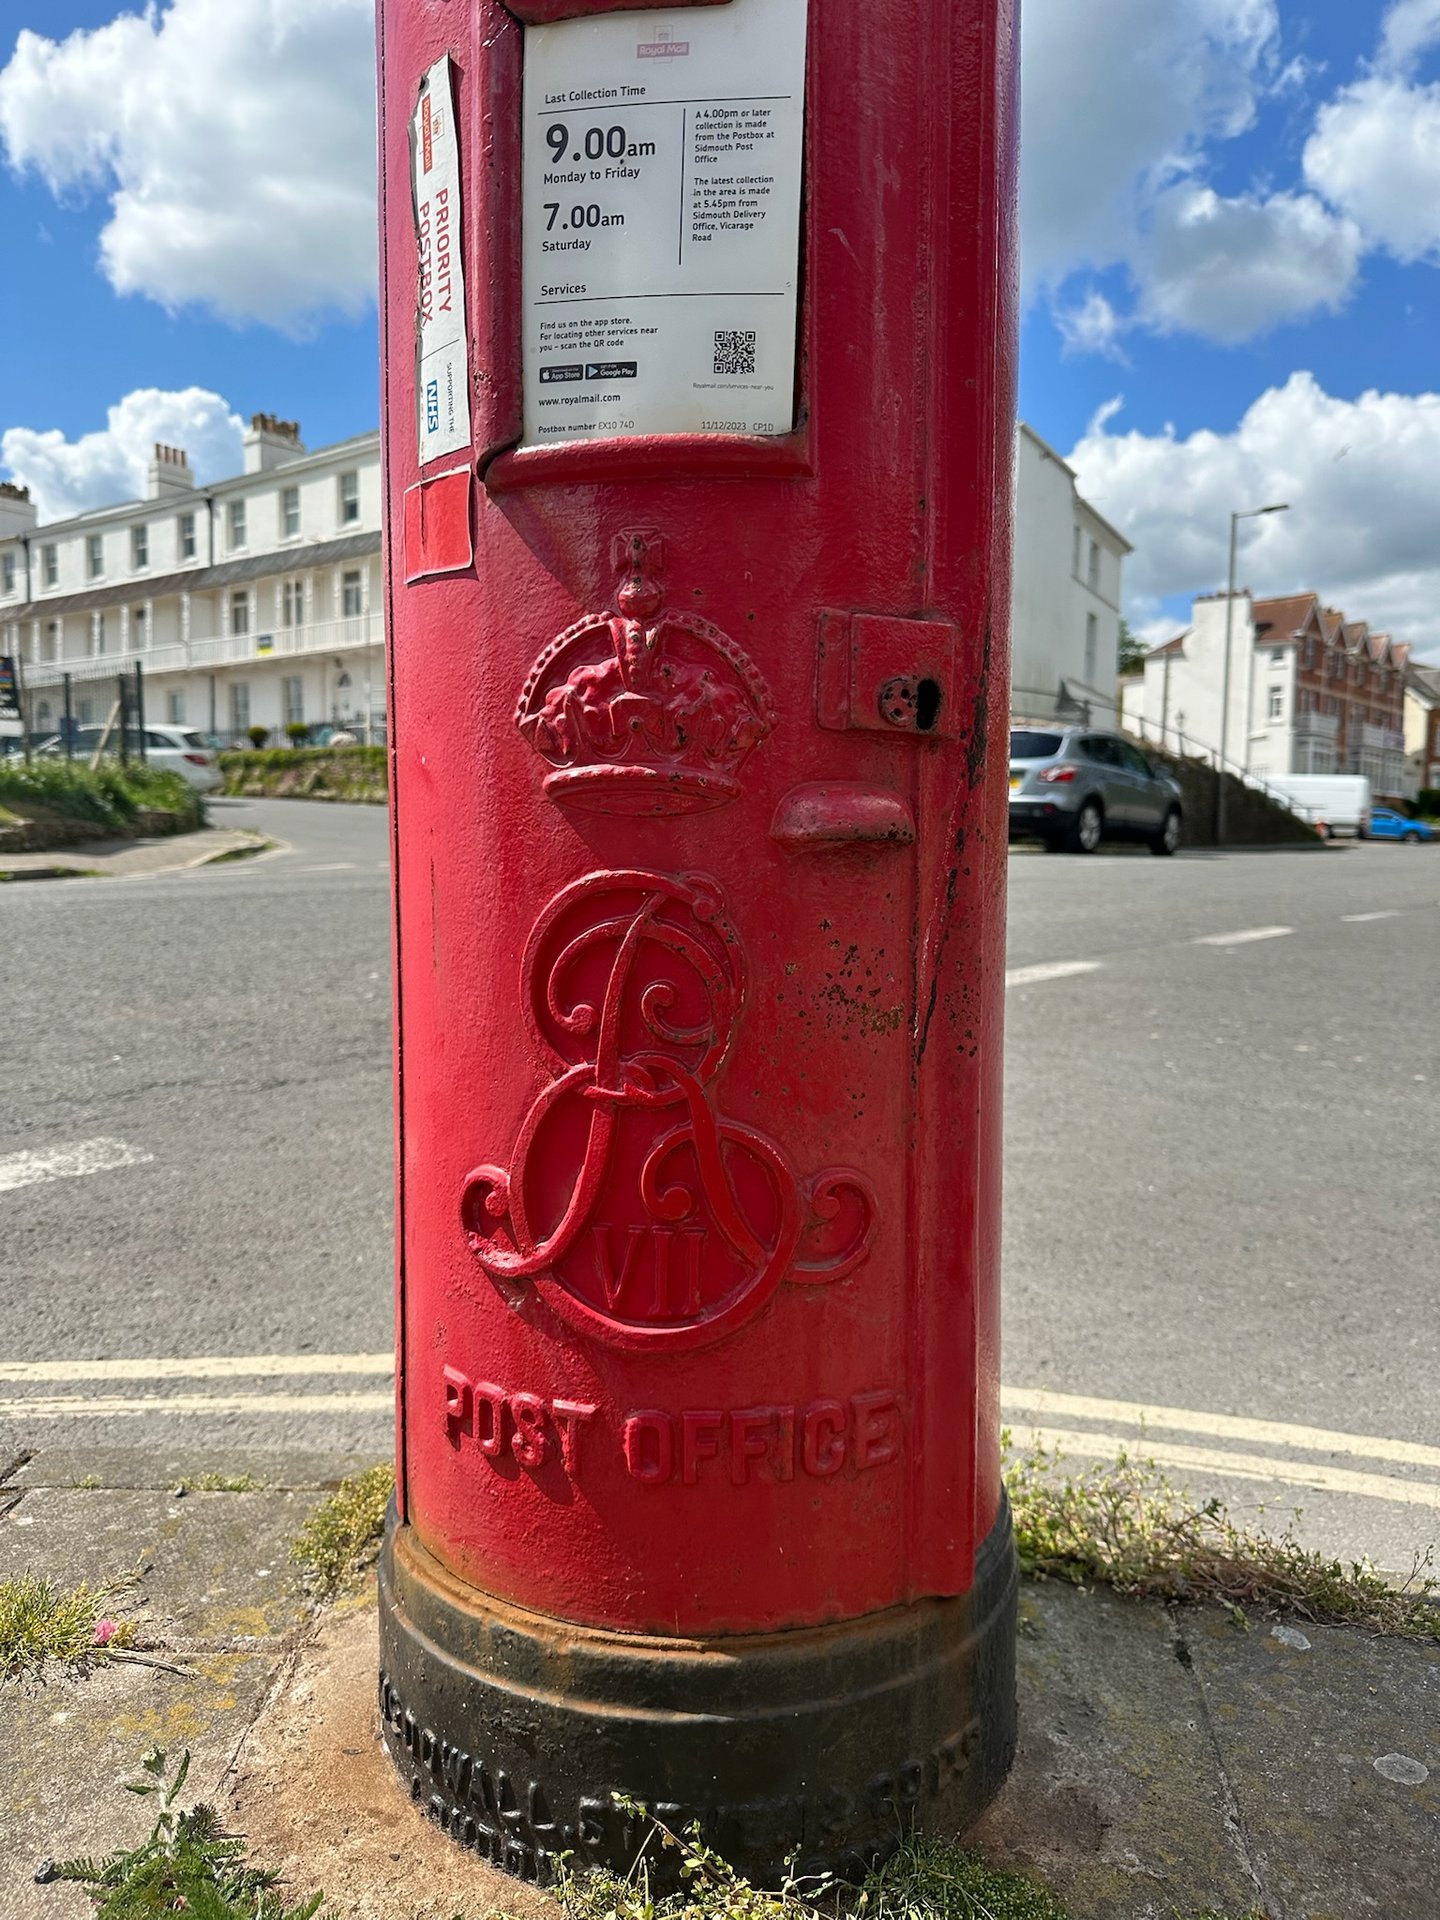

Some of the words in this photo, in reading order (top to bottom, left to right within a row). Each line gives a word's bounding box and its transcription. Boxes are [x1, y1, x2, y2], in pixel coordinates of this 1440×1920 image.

[639, 45, 665, 57] Royal
[545, 93, 566, 104] Last
[569, 88, 617, 101] Collection
[620, 86, 646, 97] Time
[423, 100, 431, 138] Royal
[695, 111, 701, 119] A
[703, 109, 738, 119] 4.00pm
[741, 110, 750, 118] or
[752, 109, 771, 117] later
[695, 121, 733, 130] collection
[735, 120, 742, 129] is
[745, 120, 767, 128] made
[695, 133, 714, 141] from
[717, 132, 730, 140] the
[732, 131, 764, 140] Postbox
[766, 131, 775, 139] at
[546, 123, 655, 164] 9.00am
[695, 143, 733, 153] Sidmouth
[735, 142, 753, 151] Post
[424, 139, 432, 170] Mail
[694, 155, 718, 163] Office
[543, 171, 586, 185] Monday
[590, 170, 601, 180] to
[605, 166, 640, 179] Friday
[694, 177, 709, 185] The
[711, 177, 734, 185] latest
[736, 175, 774, 184] collection
[693, 188, 701, 196] in
[704, 188, 716, 196] the
[719, 188, 737, 196] area
[739, 187, 746, 195] is
[748, 186, 770, 195] made
[693, 201, 701, 209] at
[703, 199, 736, 209] 5.45pm
[738, 199, 758, 207] from
[543, 202, 624, 231] 7.00am
[692, 211, 731, 220] Sidmouth
[733, 210, 766, 219] Delivery
[692, 222, 718, 231] Office,
[719, 221, 754, 230] Vicarage
[692, 233, 712, 242] Road
[436, 187, 452, 312] PRIORITY
[542, 238, 591, 252] Saturday
[419, 201, 433, 327] POSTBOX
[541, 283, 587, 296] Services
[540, 321, 556, 330] Find
[558, 321, 567, 329] us
[569, 320, 578, 328] on
[580, 319, 592, 327] the
[594, 318, 608, 327] app
[610, 317, 632, 326] store.
[540, 332, 551, 341] For
[553, 330, 583, 340] locating
[585, 328, 605, 338] other
[607, 326, 638, 336] services
[539, 344, 552, 353] you
[560, 342, 577, 350] scan
[593, 339, 605, 348] QR
[606, 338, 624, 346] code
[551, 371, 563, 381] App
[564, 371, 581, 379] Store
[600, 369, 621, 377] Google
[621, 368, 635, 376] Play
[446, 362, 454, 416] SUPPORTING
[538, 393, 621, 407] www.royalmail.com
[427, 382, 439, 432] NHS
[538, 425, 566, 434] Postbox
[568, 423, 596, 431] number
[598, 421, 618, 430] EX10
[620, 420, 635, 429] 74D
[701, 421, 747, 431] 11/12/2023
[590, 1221, 708, 1316] VII
[443, 1364, 601, 1475] POST
[623, 1388, 900, 1487] OFFICE
